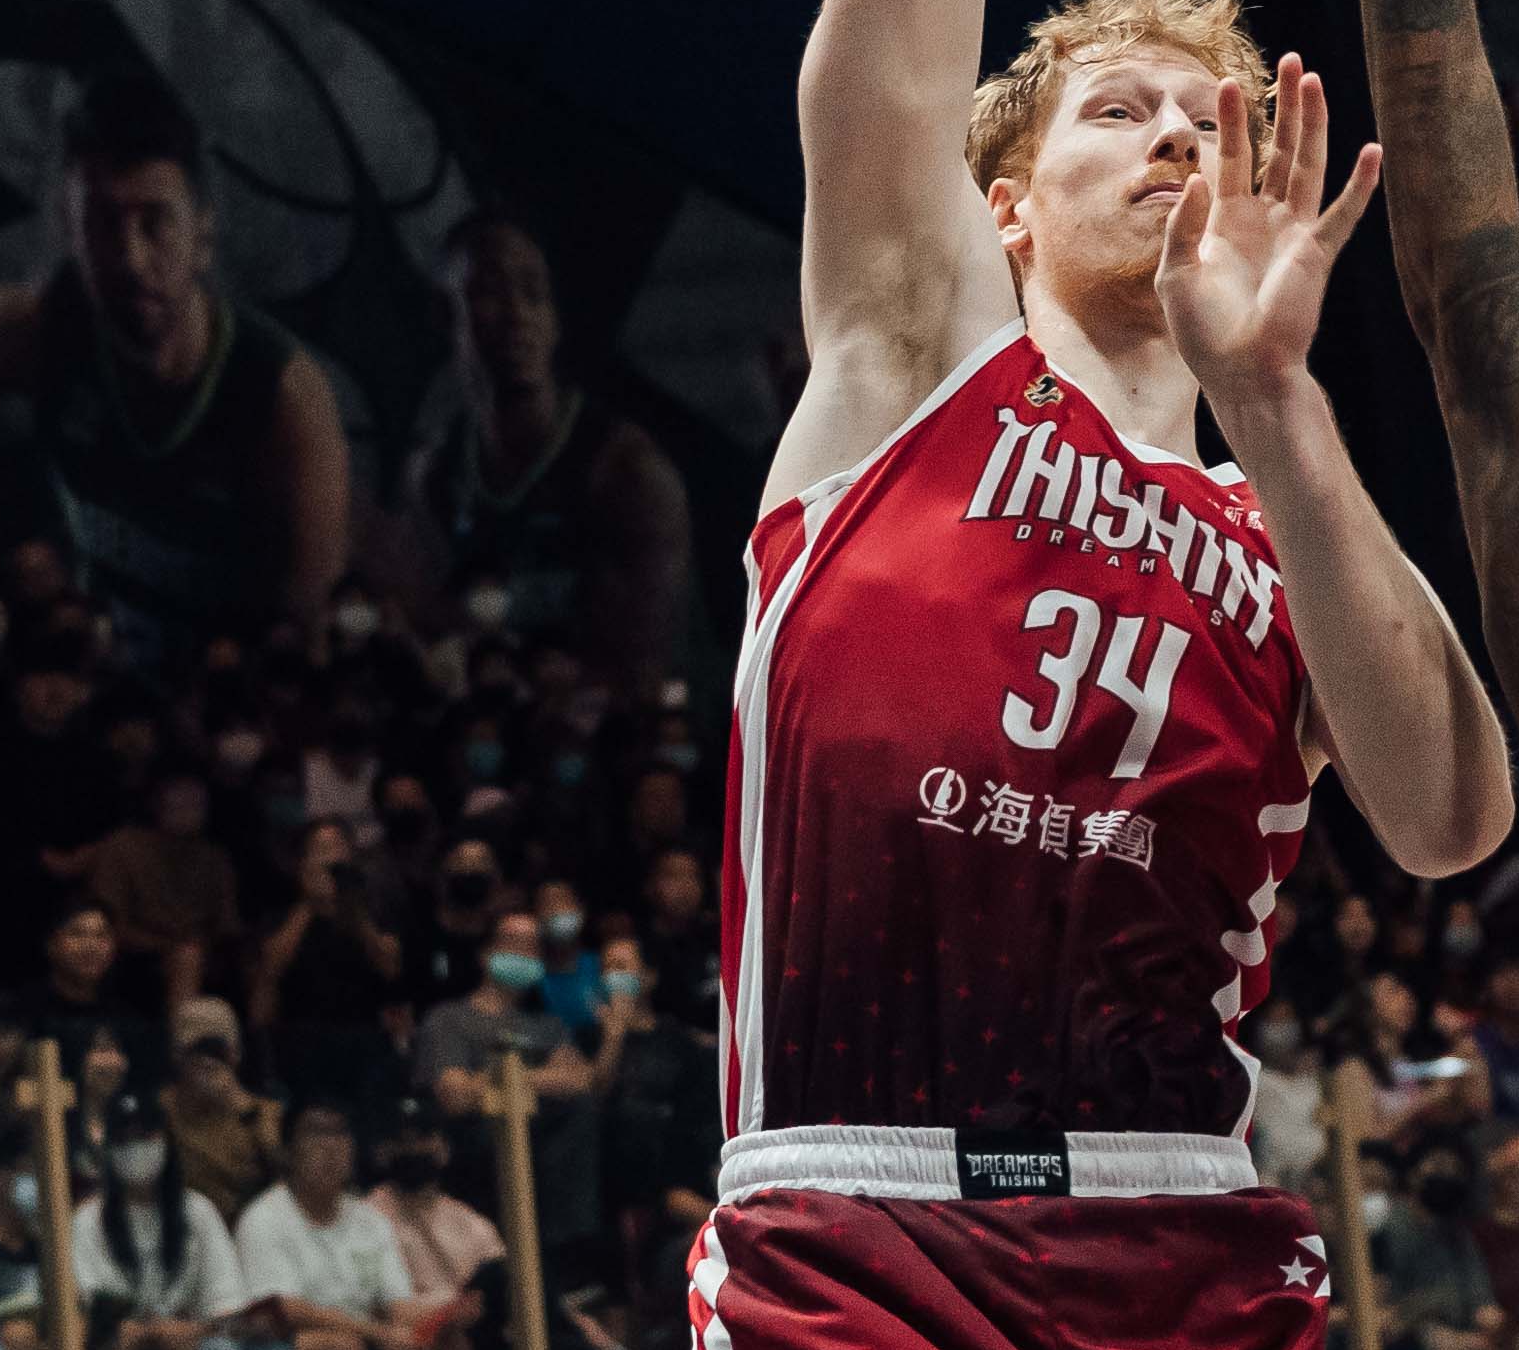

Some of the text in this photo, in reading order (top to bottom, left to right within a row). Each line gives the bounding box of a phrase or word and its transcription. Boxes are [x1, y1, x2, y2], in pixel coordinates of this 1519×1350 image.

[1015, 523, 1225, 628] DREAMS
[1000, 588, 1193, 779] 34
[965, 1152, 1063, 1178] DREAMERS
